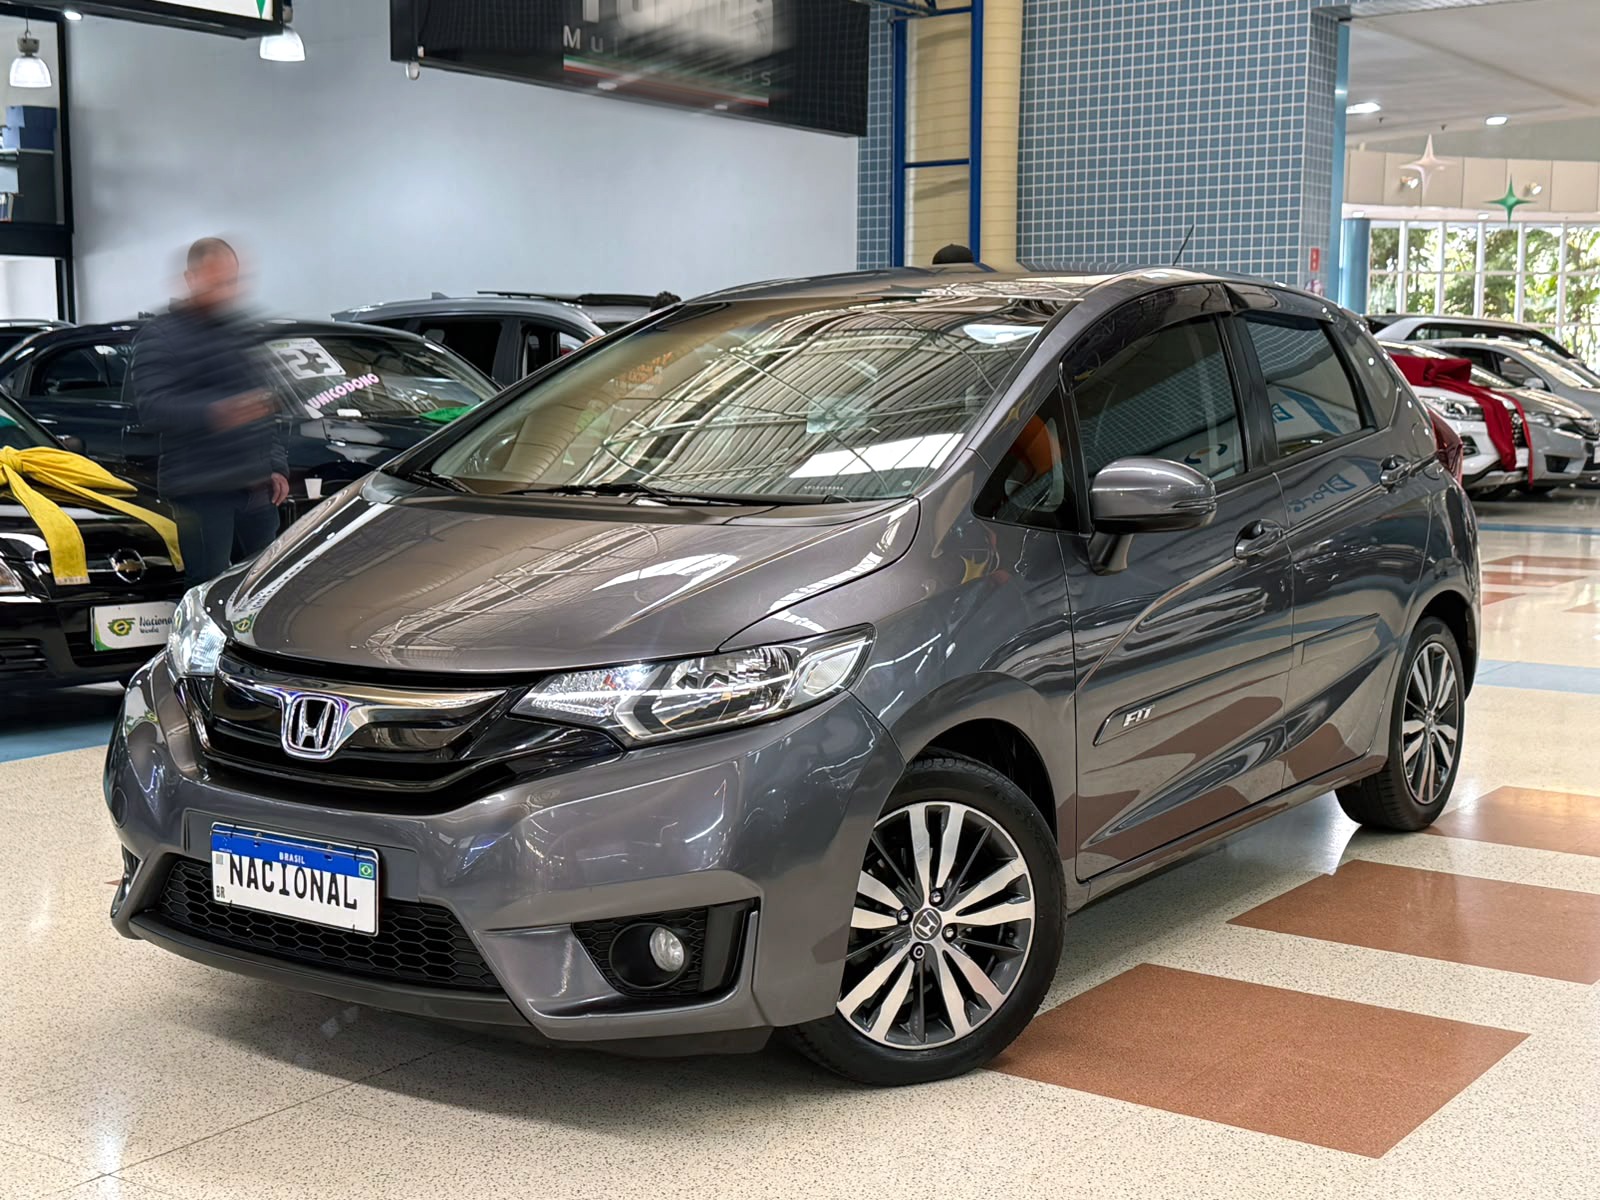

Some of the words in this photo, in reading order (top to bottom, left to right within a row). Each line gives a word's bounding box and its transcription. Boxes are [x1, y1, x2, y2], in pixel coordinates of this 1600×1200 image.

[139, 615, 175, 627] Naciona
[279, 851, 306, 864] BRASIL
[229, 853, 357, 910] NACIONAL
[215, 885, 226, 899] BR
